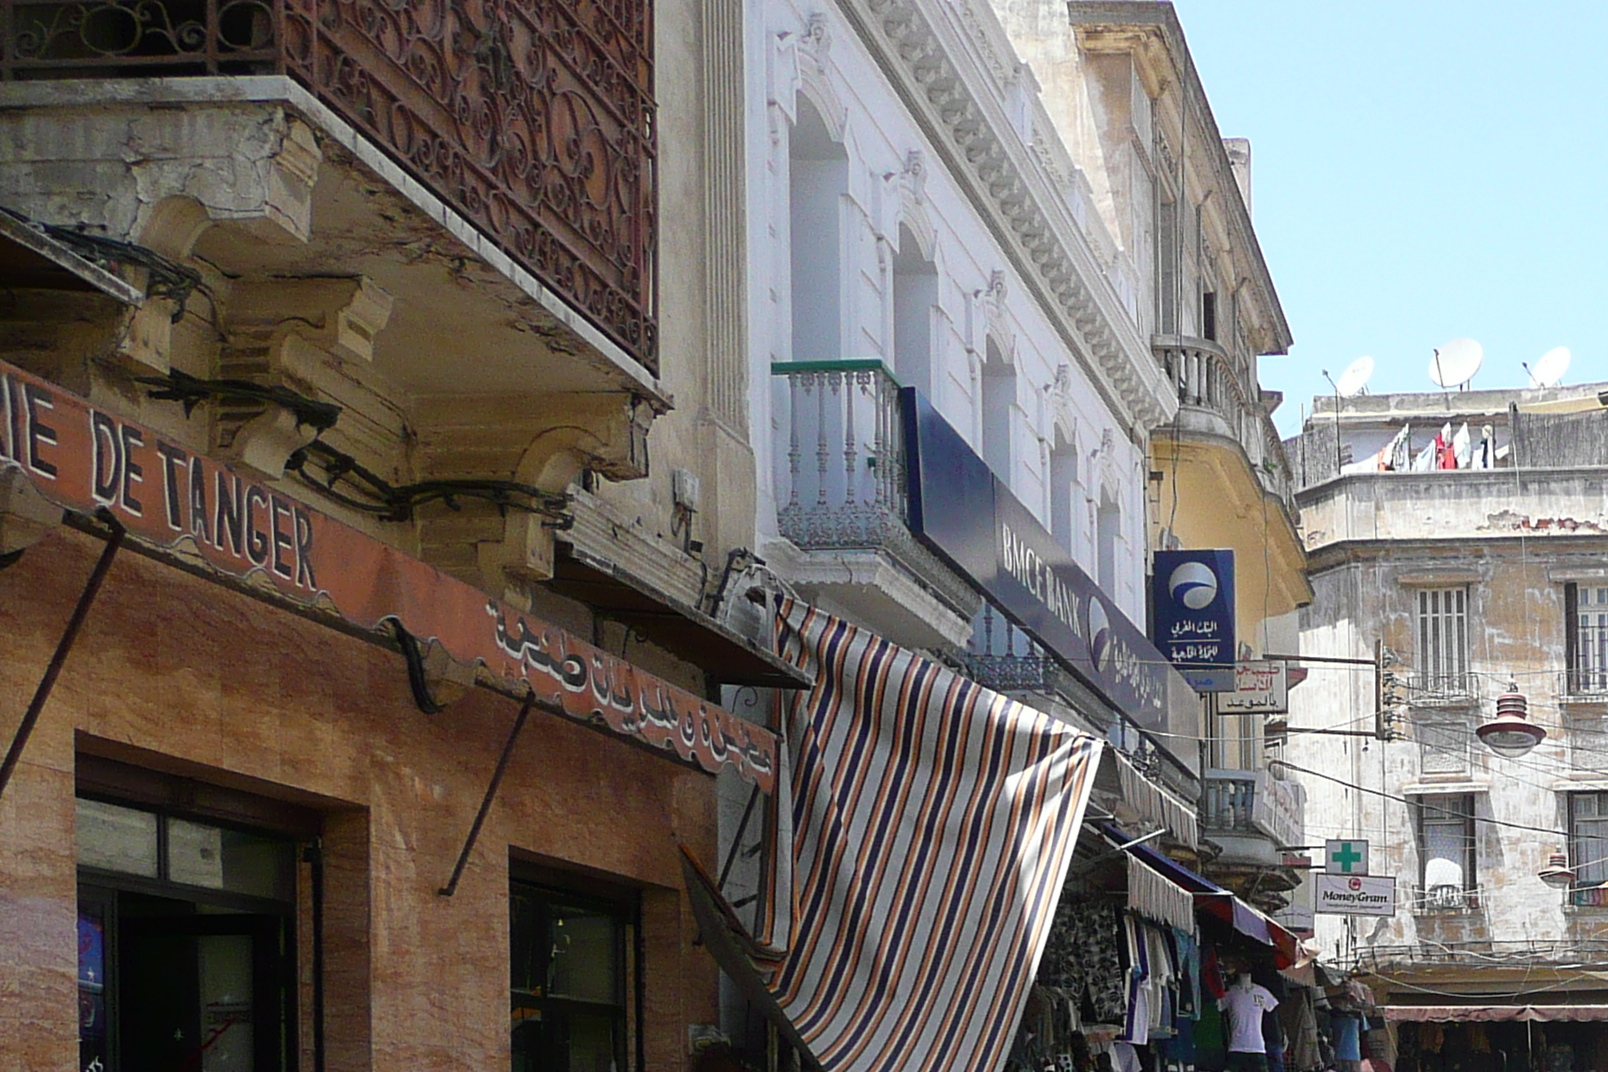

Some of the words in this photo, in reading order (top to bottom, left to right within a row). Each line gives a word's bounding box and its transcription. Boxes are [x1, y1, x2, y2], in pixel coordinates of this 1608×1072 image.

[0, 373, 57, 480] IE
[90, 408, 144, 518] DE
[157, 439, 317, 592] TANGER
[1002, 522, 1044, 603] BMCE
[1046, 566, 1081, 638] BANK
[485, 600, 589, 693] طنجة
[1322, 890, 1388, 904] MoneyGram
